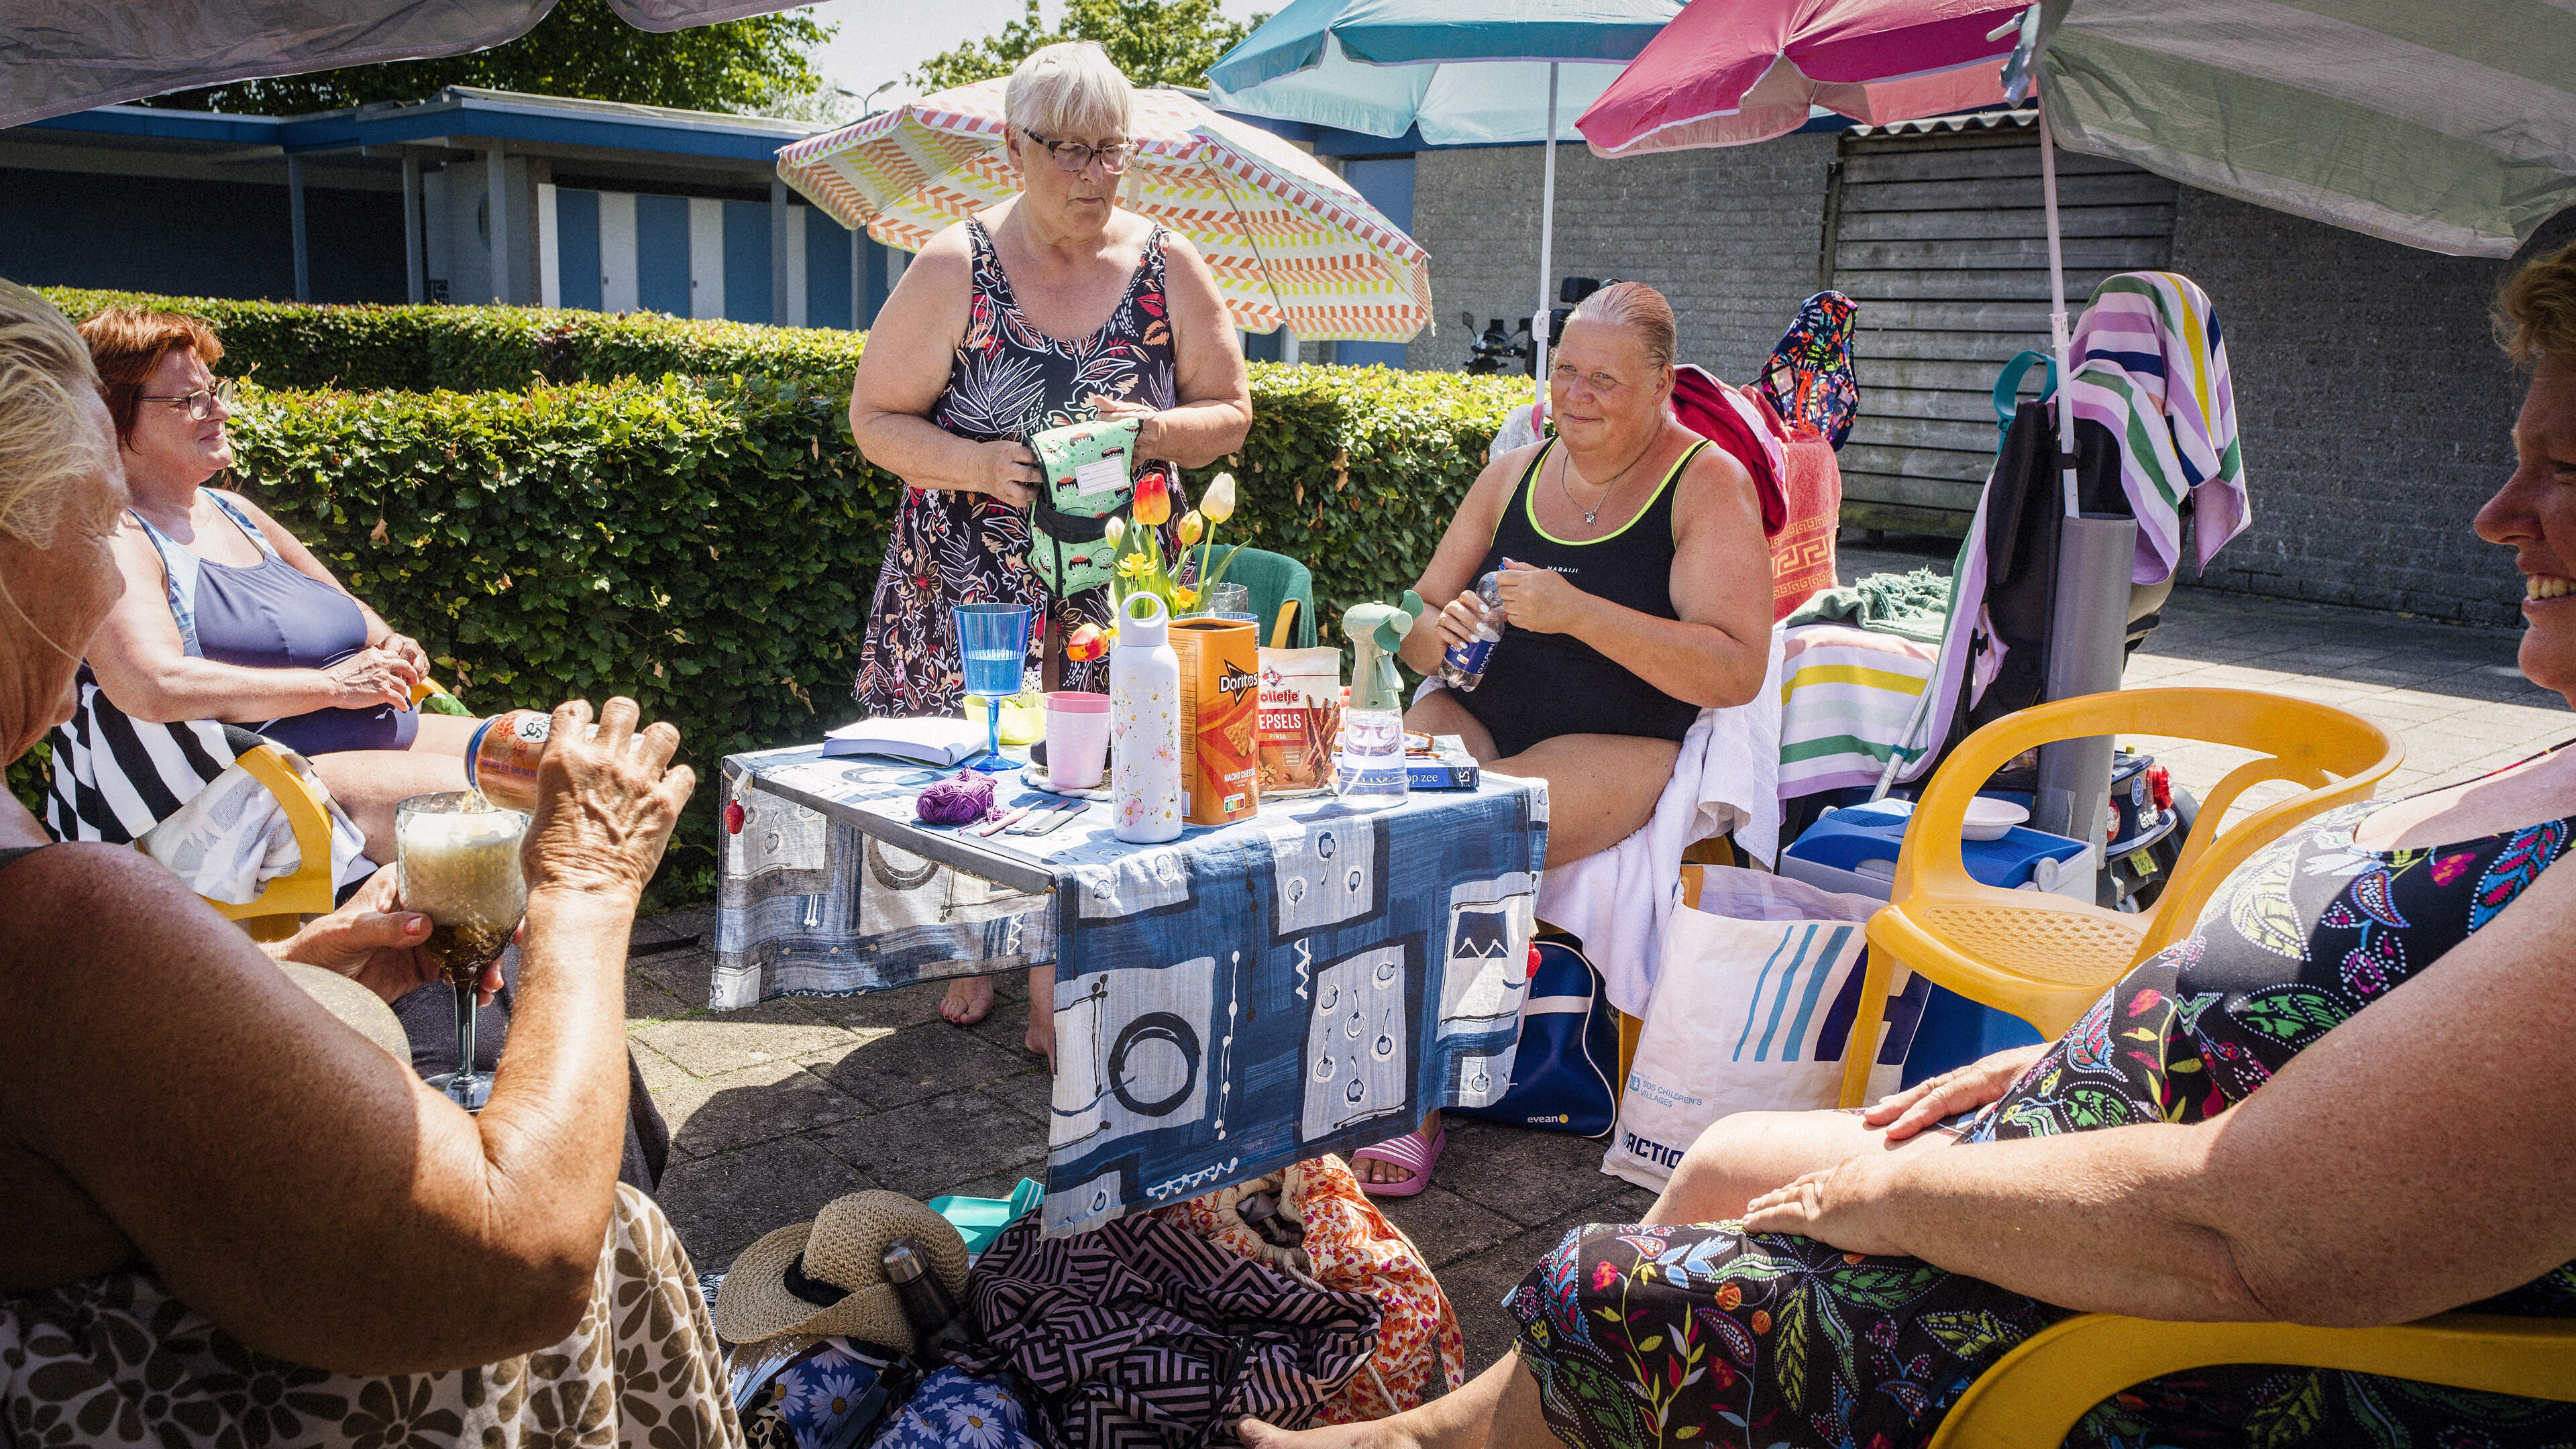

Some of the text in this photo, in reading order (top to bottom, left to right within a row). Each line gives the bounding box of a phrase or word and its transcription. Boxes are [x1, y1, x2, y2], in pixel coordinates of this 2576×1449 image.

[1220, 672, 1258, 693] Doritos
[1259, 690, 1299, 706] olletje
[1258, 713, 1301, 730] EPSELS
[1224, 767, 1256, 782] NACHO CHEESE
[1421, 774, 1438, 782] zee
[1641, 1089, 1673, 1108] VILLAGES
[1642, 1080, 1703, 1106] SOS CHILDREN'S
[1626, 1132, 1685, 1170] ACTIO
